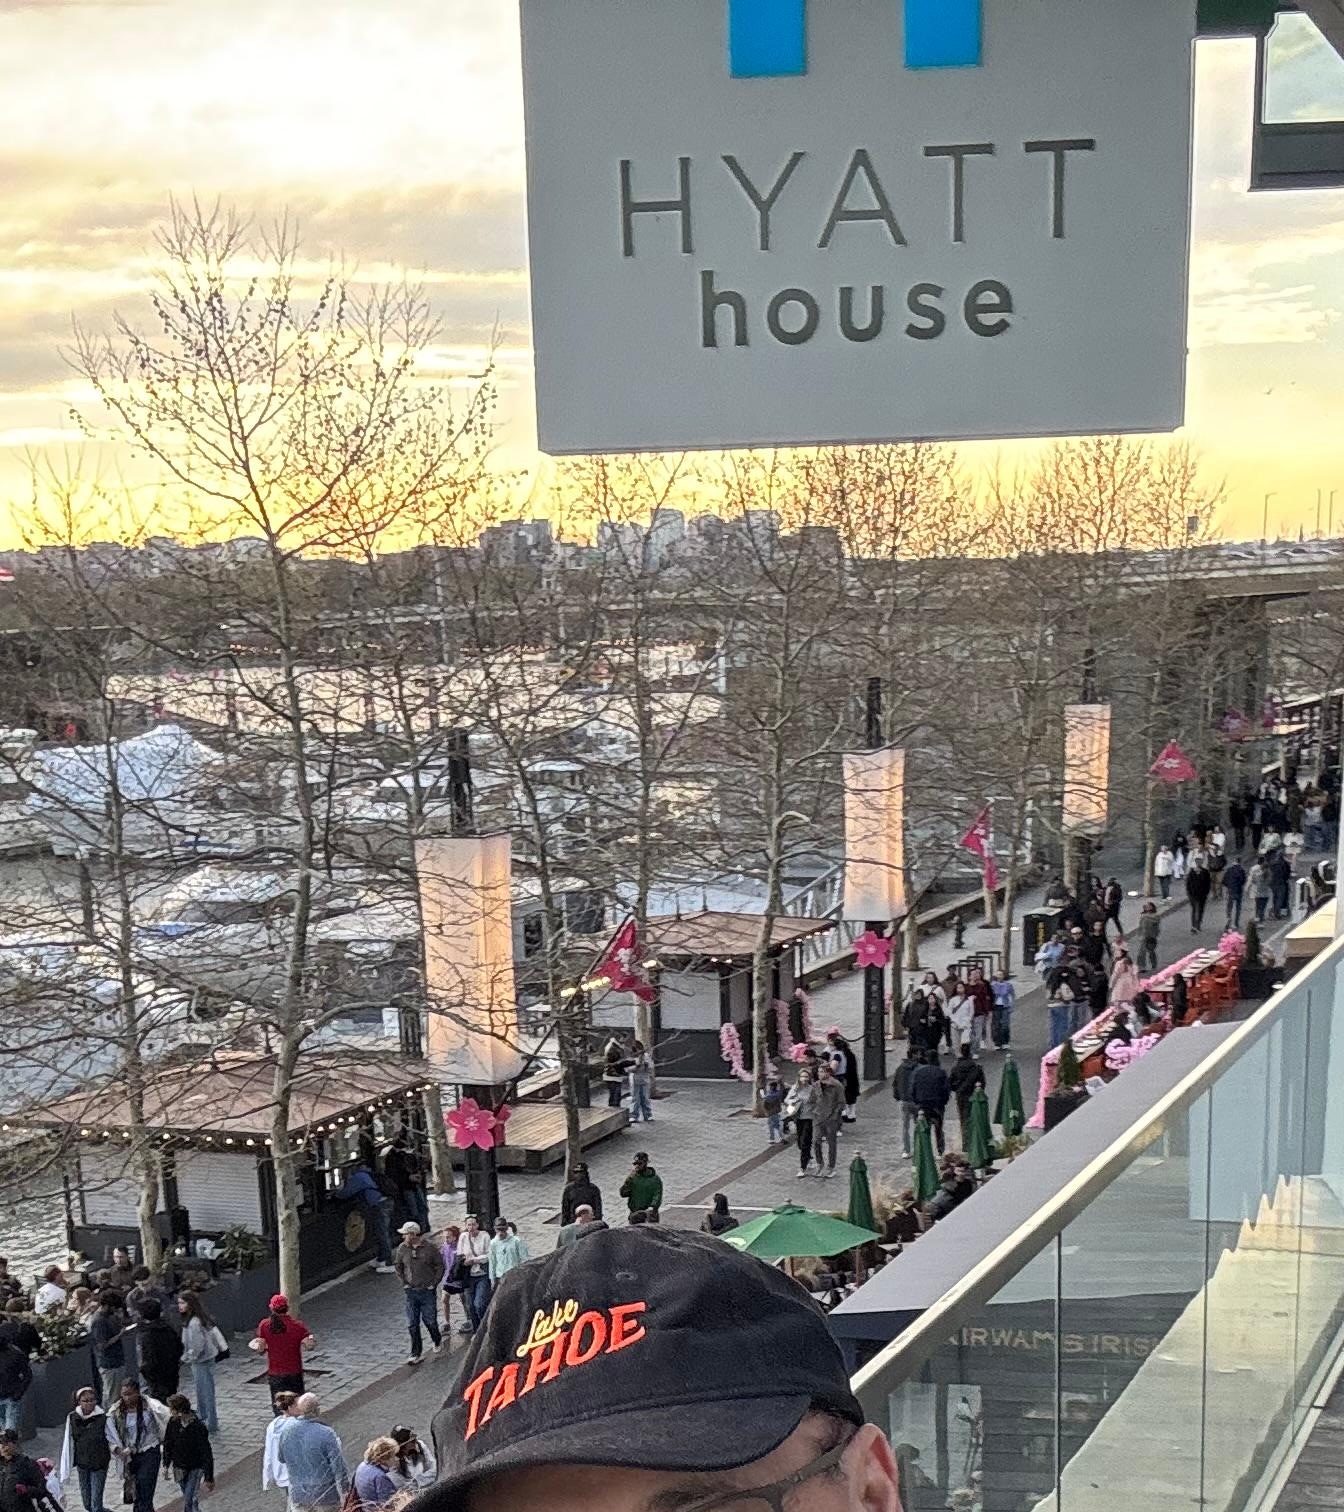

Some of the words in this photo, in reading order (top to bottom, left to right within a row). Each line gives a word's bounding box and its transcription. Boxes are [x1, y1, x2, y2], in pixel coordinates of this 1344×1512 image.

[620, 138, 1096, 257] HYATT
[701, 269, 1014, 348] house
[464, 1302, 647, 1441] TAHOE
[515, 1299, 578, 1358] Lake
